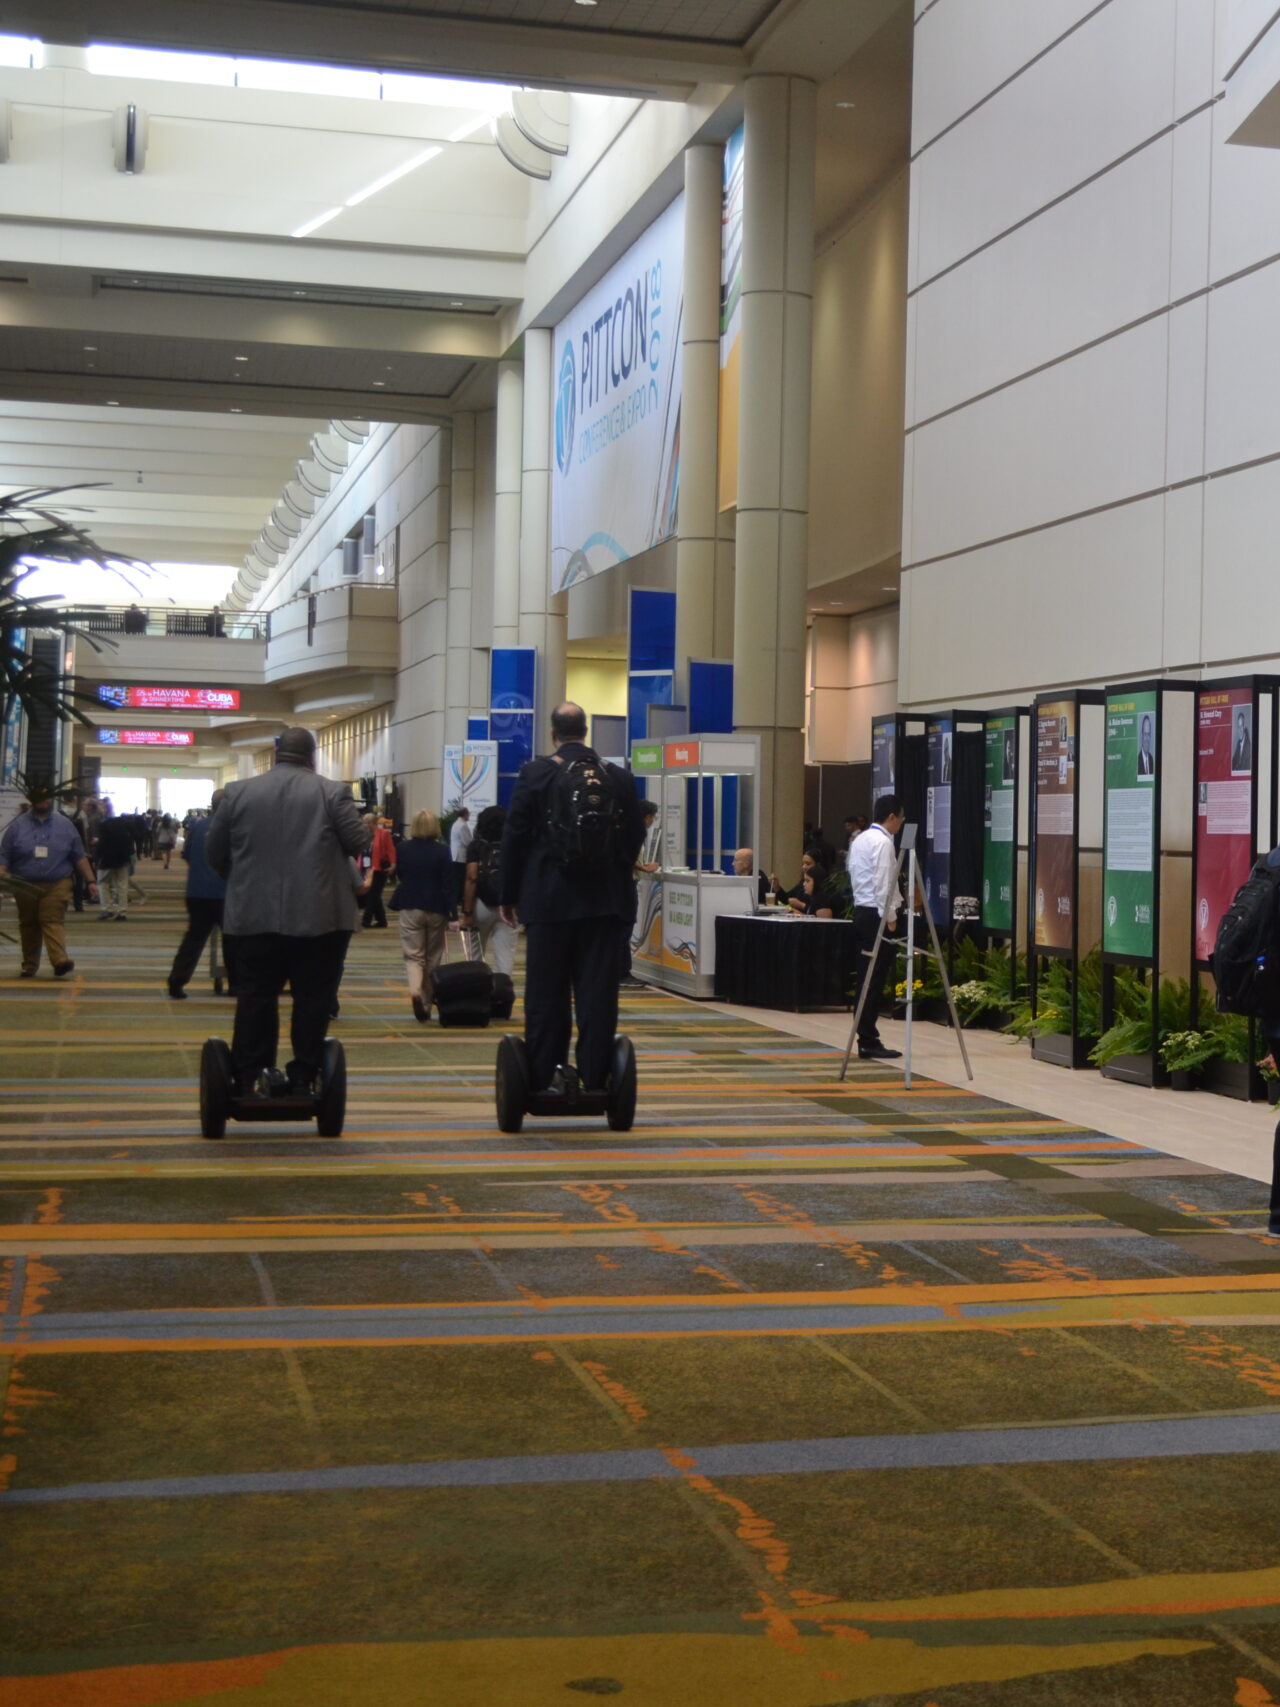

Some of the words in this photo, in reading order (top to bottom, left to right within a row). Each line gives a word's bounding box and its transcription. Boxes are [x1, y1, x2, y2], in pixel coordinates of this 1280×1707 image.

[581, 272, 648, 415] PITTCON
[579, 404, 620, 464] CONFERENCE
[627, 384, 646, 430] EXPO
[152, 689, 191, 698] HAVANA
[207, 693, 234, 702] CUBA
